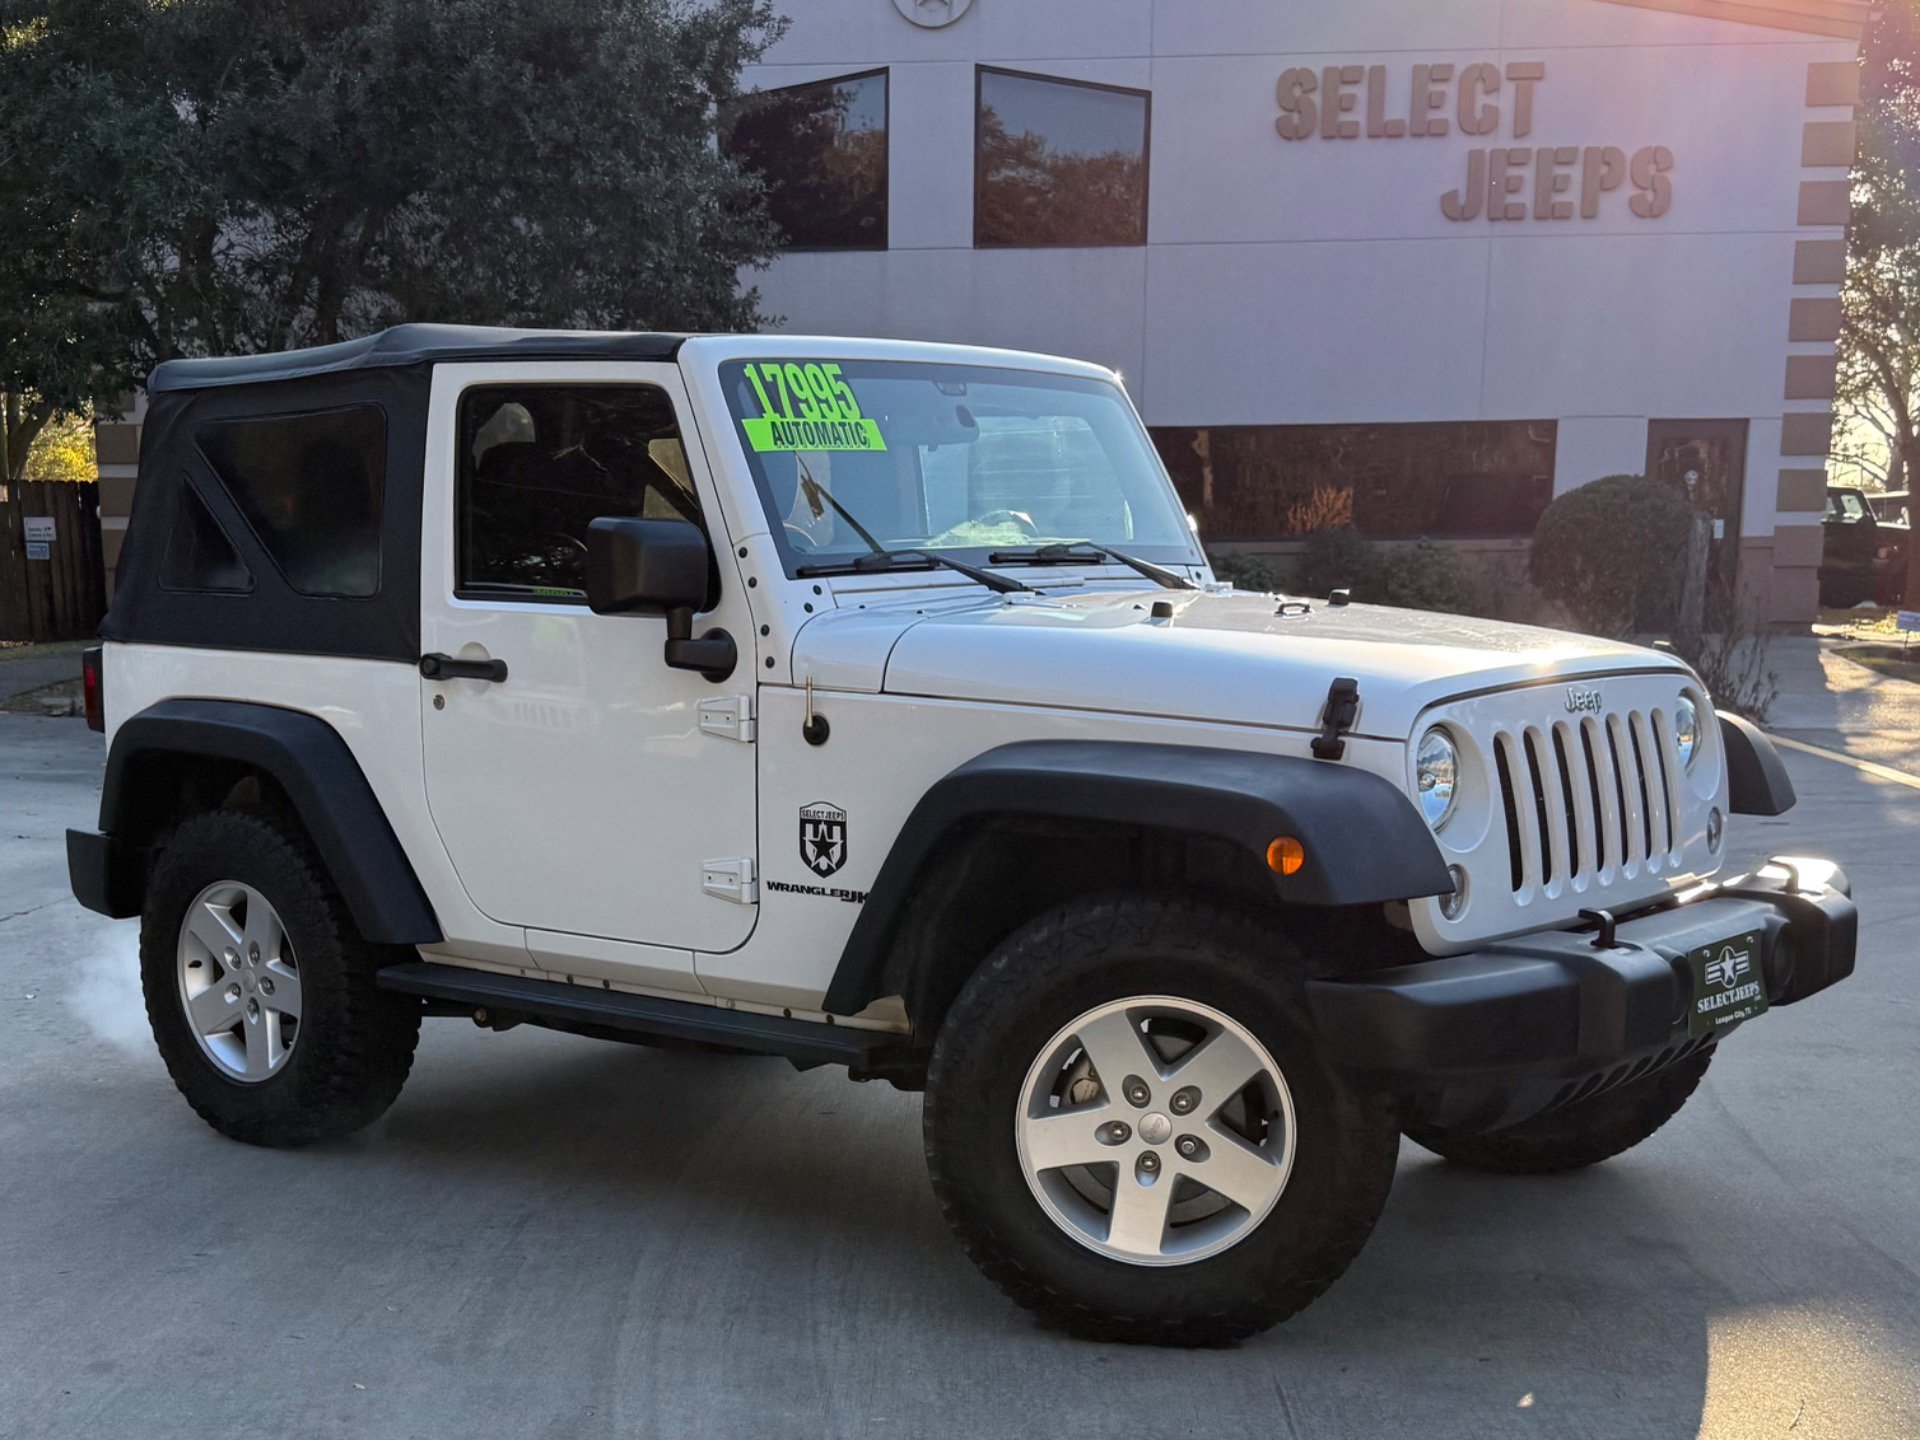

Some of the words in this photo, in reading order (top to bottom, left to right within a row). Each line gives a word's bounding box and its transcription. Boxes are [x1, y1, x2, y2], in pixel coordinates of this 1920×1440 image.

[1275, 61, 1545, 140] SELECT
[1440, 146, 1674, 221] JEEPS
[744, 363, 862, 420] 17995
[770, 421, 871, 449] AUTOMATIC
[1565, 687, 1603, 715] Jeep
